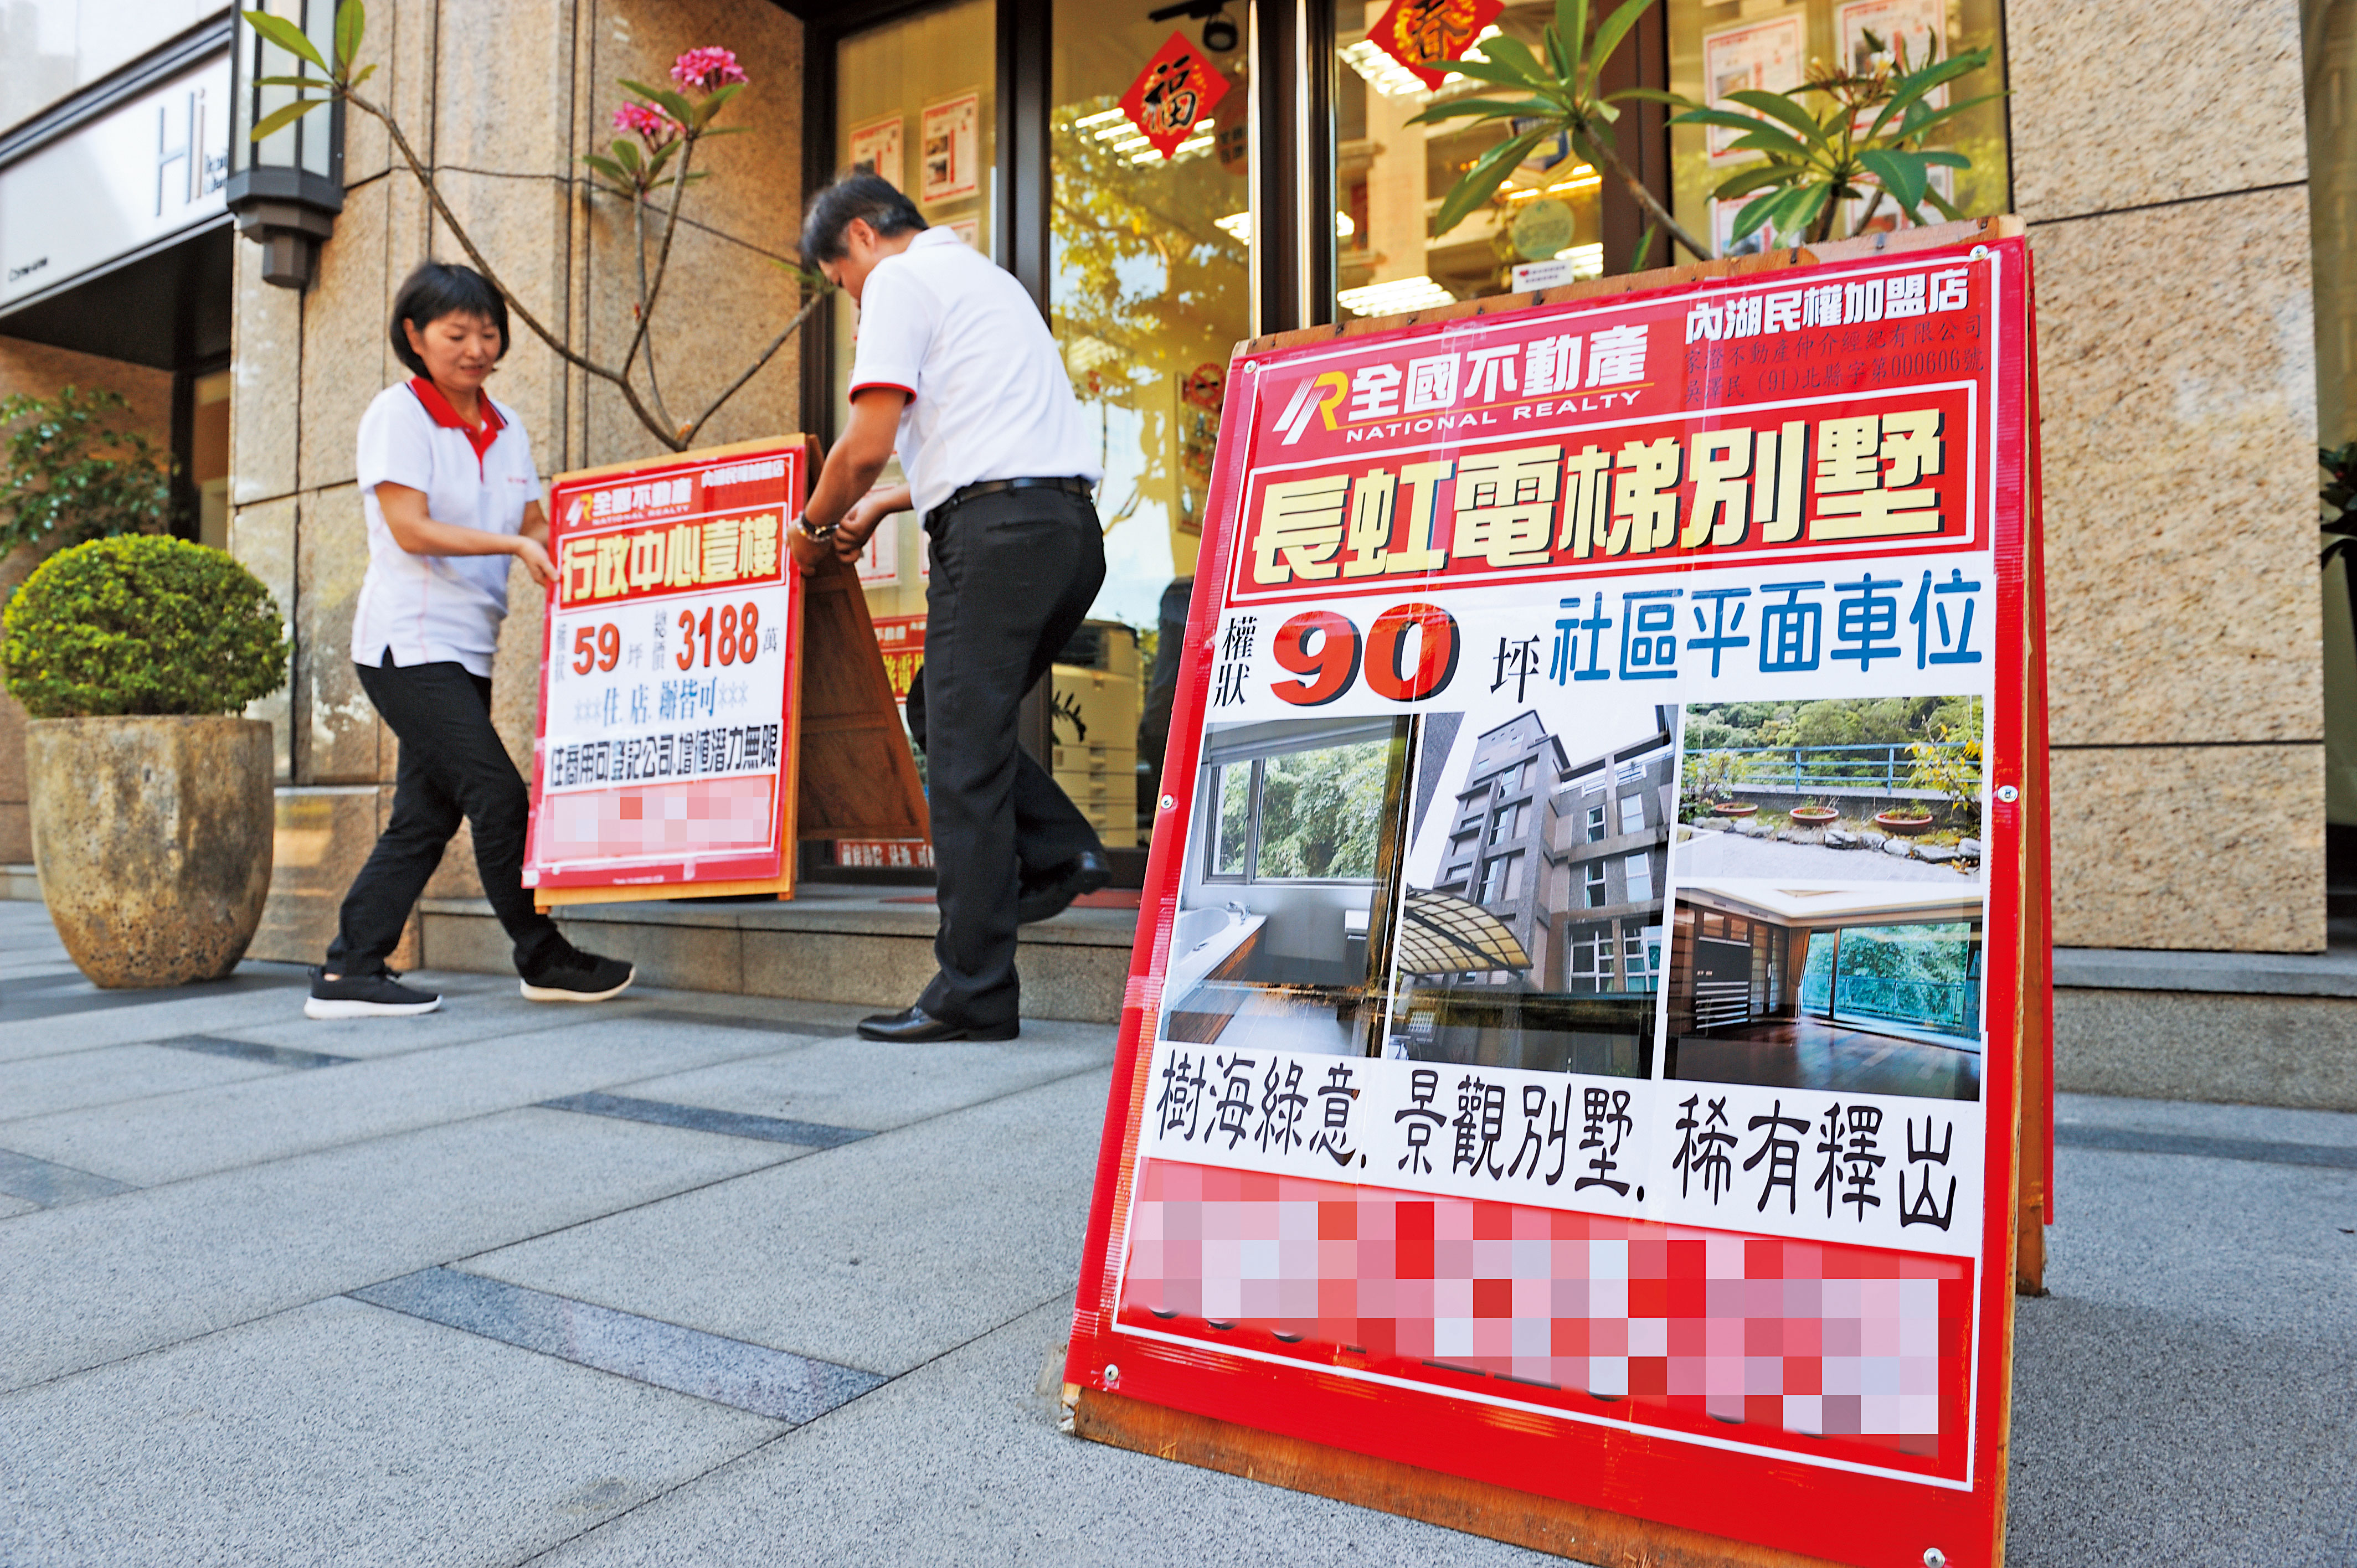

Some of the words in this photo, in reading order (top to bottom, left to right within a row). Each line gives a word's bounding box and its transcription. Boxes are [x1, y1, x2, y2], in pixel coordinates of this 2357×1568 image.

[1143, 55, 1196, 130] 福
[156, 88, 205, 216] Hi
[1685, 267, 1969, 345] 內湖民權加盟店
[1346, 411, 1497, 442] NATIONAL
[1513, 390, 1641, 420] REALTY
[1348, 323, 1649, 422] 全國不動產
[1252, 407, 1946, 586] 長虹電梯別墅
[562, 514, 778, 602] 行政中心壹樓
[573, 623, 620, 675] 59
[676, 602, 759, 671] 3188
[763, 627, 779, 654] 萬
[1213, 616, 1258, 708] 權狀
[1269, 602, 1461, 709] 90
[1490, 634, 1541, 705] 坪
[1549, 568, 1984, 687] 社區平面車位
